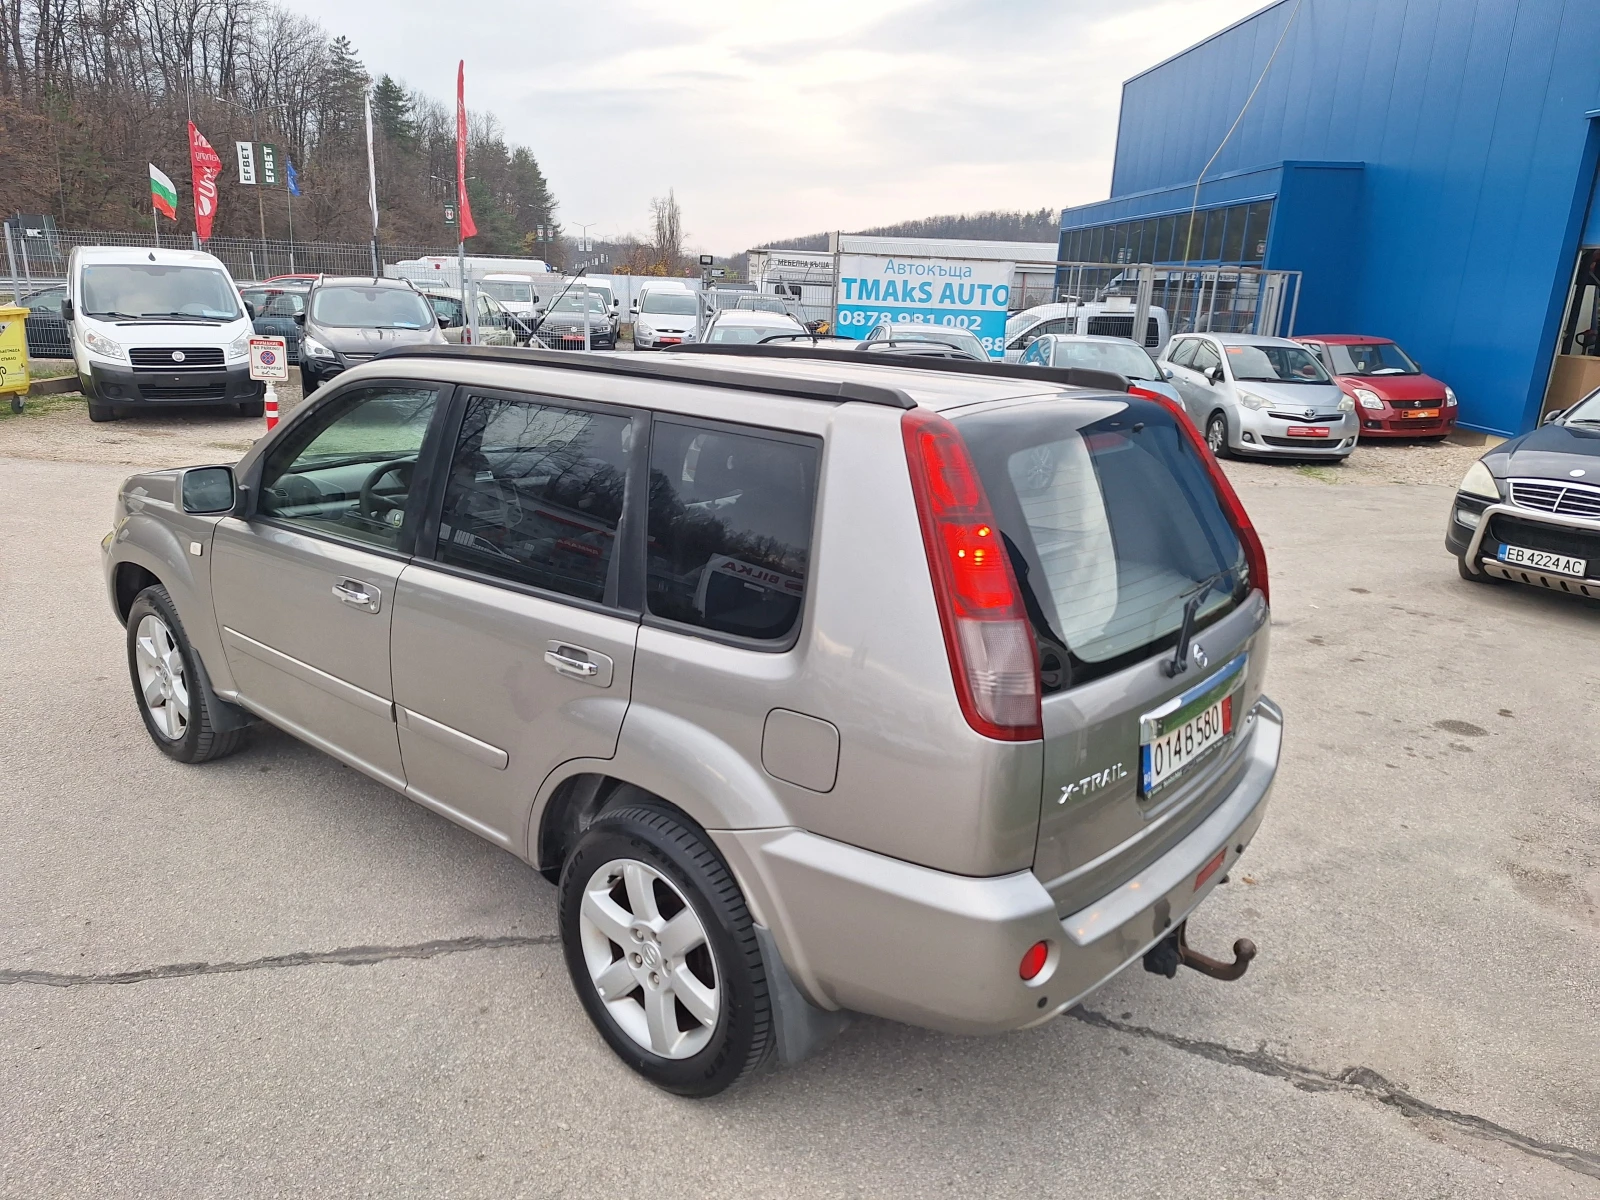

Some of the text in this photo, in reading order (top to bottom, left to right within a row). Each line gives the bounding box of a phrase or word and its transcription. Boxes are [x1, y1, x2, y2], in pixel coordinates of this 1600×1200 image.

[240, 144, 252, 182] EFBET
[263, 145, 275, 183] EFBET
[884, 258, 972, 280] Автокъща
[841, 277, 1009, 307] TMAkS AUTO
[838, 310, 892, 326] 0878
[943, 315, 982, 331] 002
[1506, 547, 1582, 574] EB 4224 AC
[1057, 762, 1128, 805] X-TRAIL
